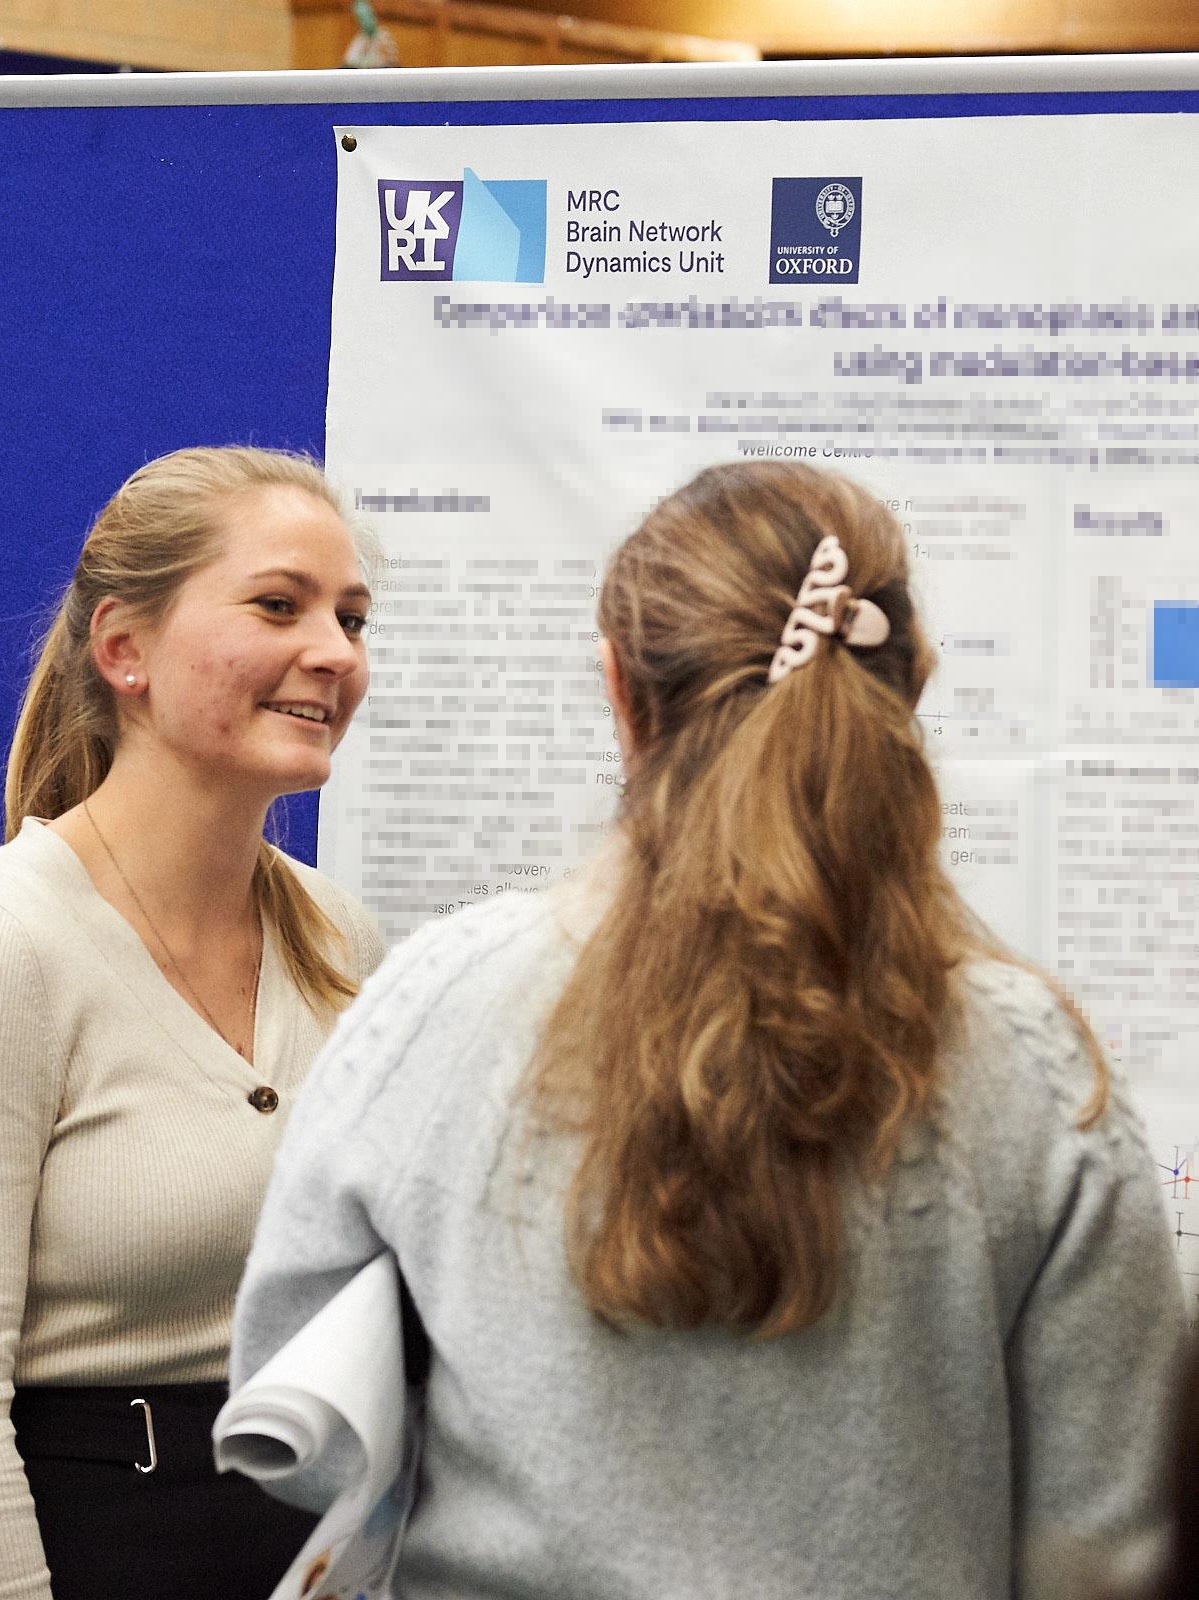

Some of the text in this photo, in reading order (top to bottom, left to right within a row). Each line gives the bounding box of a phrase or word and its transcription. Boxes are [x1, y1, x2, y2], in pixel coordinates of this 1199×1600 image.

[567, 190, 620, 211] MRC
[567, 220, 723, 243] Brain Network
[777, 246, 840, 255] UNIVERSITY OF
[566, 250, 725, 278] Dynamics Unit
[775, 258, 853, 275] OXFORD
